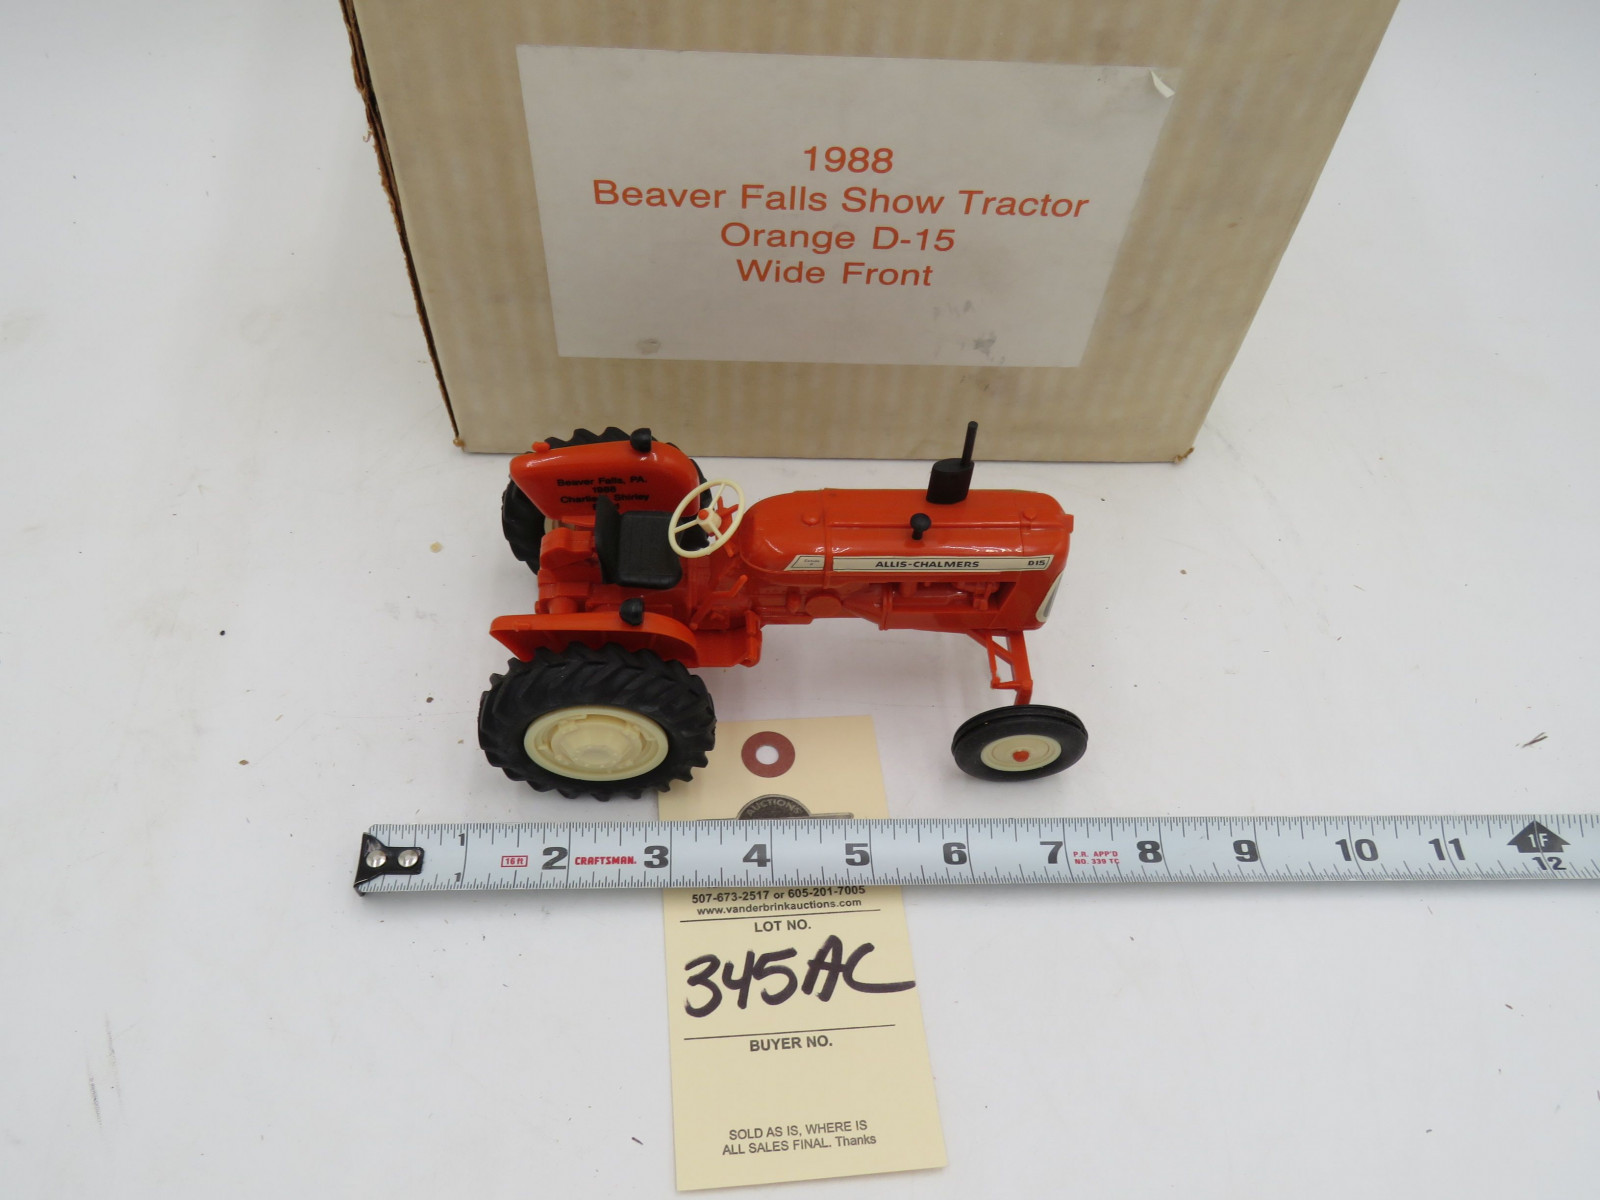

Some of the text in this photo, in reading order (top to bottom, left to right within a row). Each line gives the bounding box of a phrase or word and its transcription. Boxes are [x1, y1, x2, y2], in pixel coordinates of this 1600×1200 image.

[803, 146, 894, 174] 1988
[592, 179, 1089, 218] Beaver Falls Show Tractor
[720, 222, 955, 254] Orange D-15
[736, 258, 933, 287] Wide Front
[556, 479, 594, 487] Beaver
[598, 477, 625, 485] Falls,
[614, 494, 649, 502] Shirley
[875, 559, 1046, 568] ALLIS-CHALMERS D15
[746, 798, 802, 816] AUCTIONS
[458, 833, 465, 846] 1
[1335, 838, 1379, 862] 10
[1428, 838, 1466, 861] 11
[1528, 833, 1549, 848] 1F
[505, 857, 524, 865] 16 ft
[541, 846, 568, 870] 2
[643, 845, 669, 868] 3
[742, 843, 771, 867] 4
[845, 843, 870, 866] 5
[942, 842, 968, 866] 6
[1039, 841, 1064, 864] 7
[1136, 840, 1162, 863] 8
[1232, 840, 1259, 863] 9
[1532, 856, 1567, 871] 12
[454, 872, 461, 882] 1
[692, 885, 866, 904] 507-673-2517 or 605-201-7005
[697, 898, 862, 916] www.vanderbrinkauctions.com
[754, 919, 812, 933] LOT NO.
[684, 934, 916, 1018] 345AC
[750, 1035, 833, 1052] BUYER NO.
[729, 1120, 868, 1141] SOLD AS IS, WHERE IS
[722, 1134, 877, 1156] ALL SALES FINAL. Thanks
